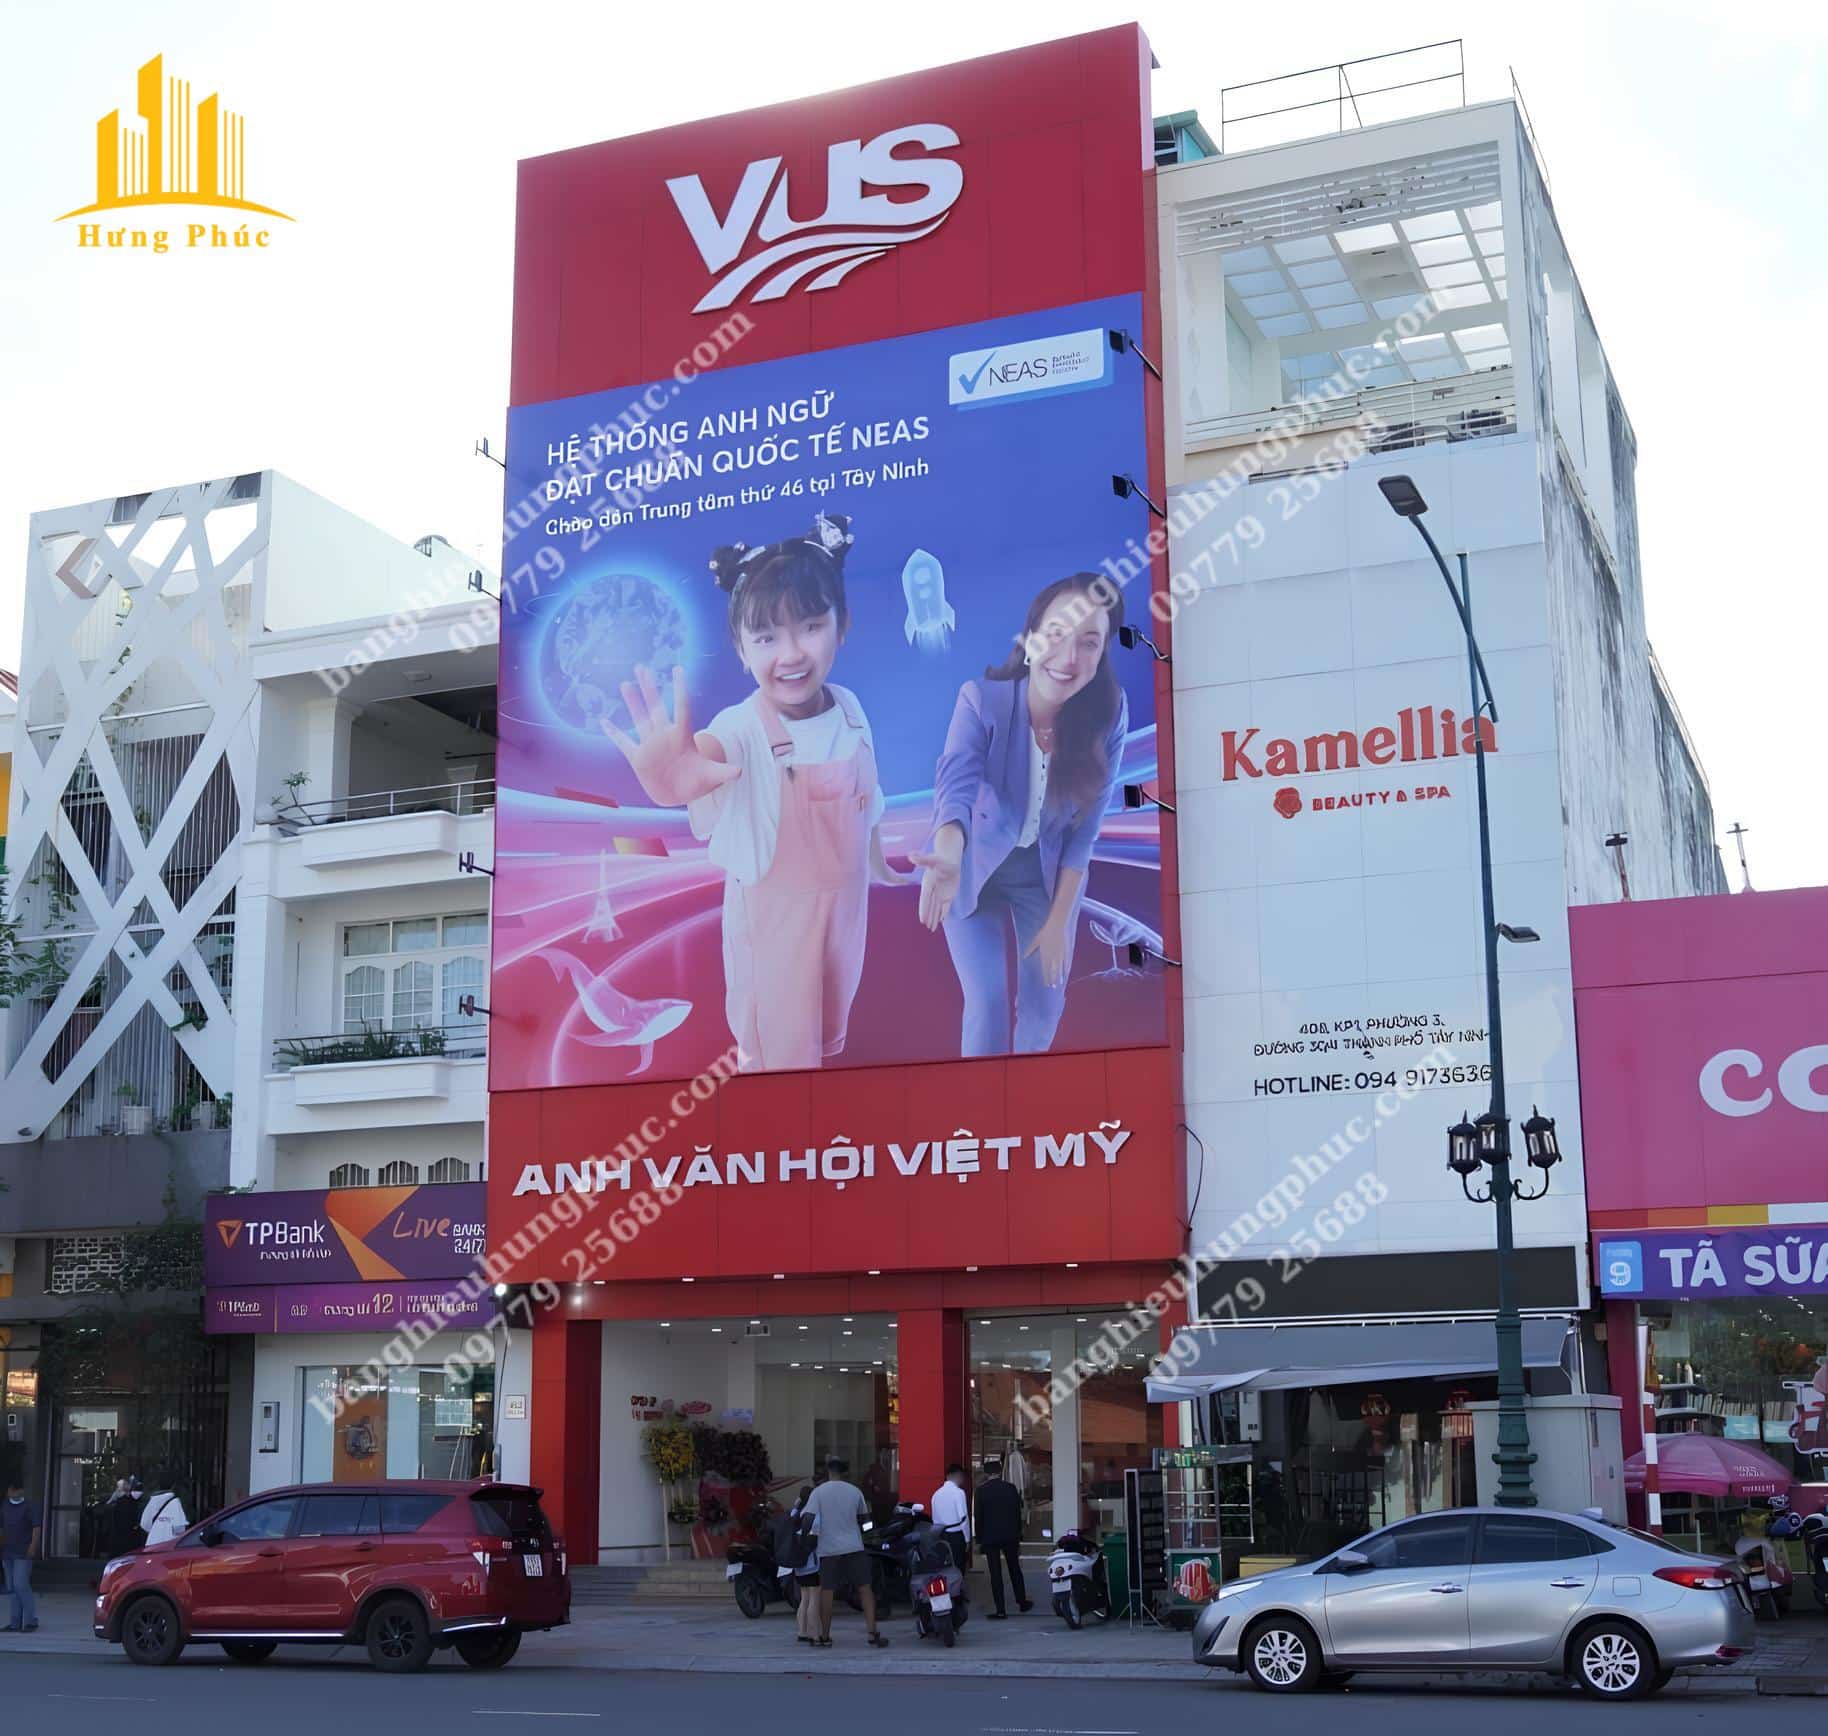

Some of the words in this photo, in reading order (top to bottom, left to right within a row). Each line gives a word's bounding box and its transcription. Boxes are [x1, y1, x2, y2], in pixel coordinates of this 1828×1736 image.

[665, 122, 964, 275] VUS
[989, 358, 1048, 387] NEAS
[547, 434, 581, 468] HỆ
[589, 420, 688, 458] THỐNG
[697, 407, 757, 440] ANH
[767, 389, 835, 427] NGỮ
[545, 473, 598, 505] ĐẠT
[712, 433, 800, 474] QUỐC
[808, 421, 846, 457] TẾ
[852, 416, 930, 451] NEAS
[640, 500, 691, 519] Trung
[697, 494, 735, 512] tâm
[780, 479, 804, 497] 46
[842, 468, 876, 488] Tây
[1221, 705, 1499, 781] Kamellia
[1312, 789, 1391, 811] BEAUTY
[1415, 785, 1452, 800] SPA
[1254, 1074, 1350, 1097] HOTLINE:
[1355, 1071, 1397, 1090] 094
[1406, 1065, 1493, 1087] 9173636
[513, 1158, 632, 1197] ANH
[642, 1146, 767, 1190] VĂN
[780, 1134, 875, 1190] HỘI
[887, 1128, 1021, 1183] VIỆT
[1034, 1119, 1133, 1169] MỸ
[245, 1217, 326, 1246] TPBank
[1659, 1239, 1727, 1288] TÃ
